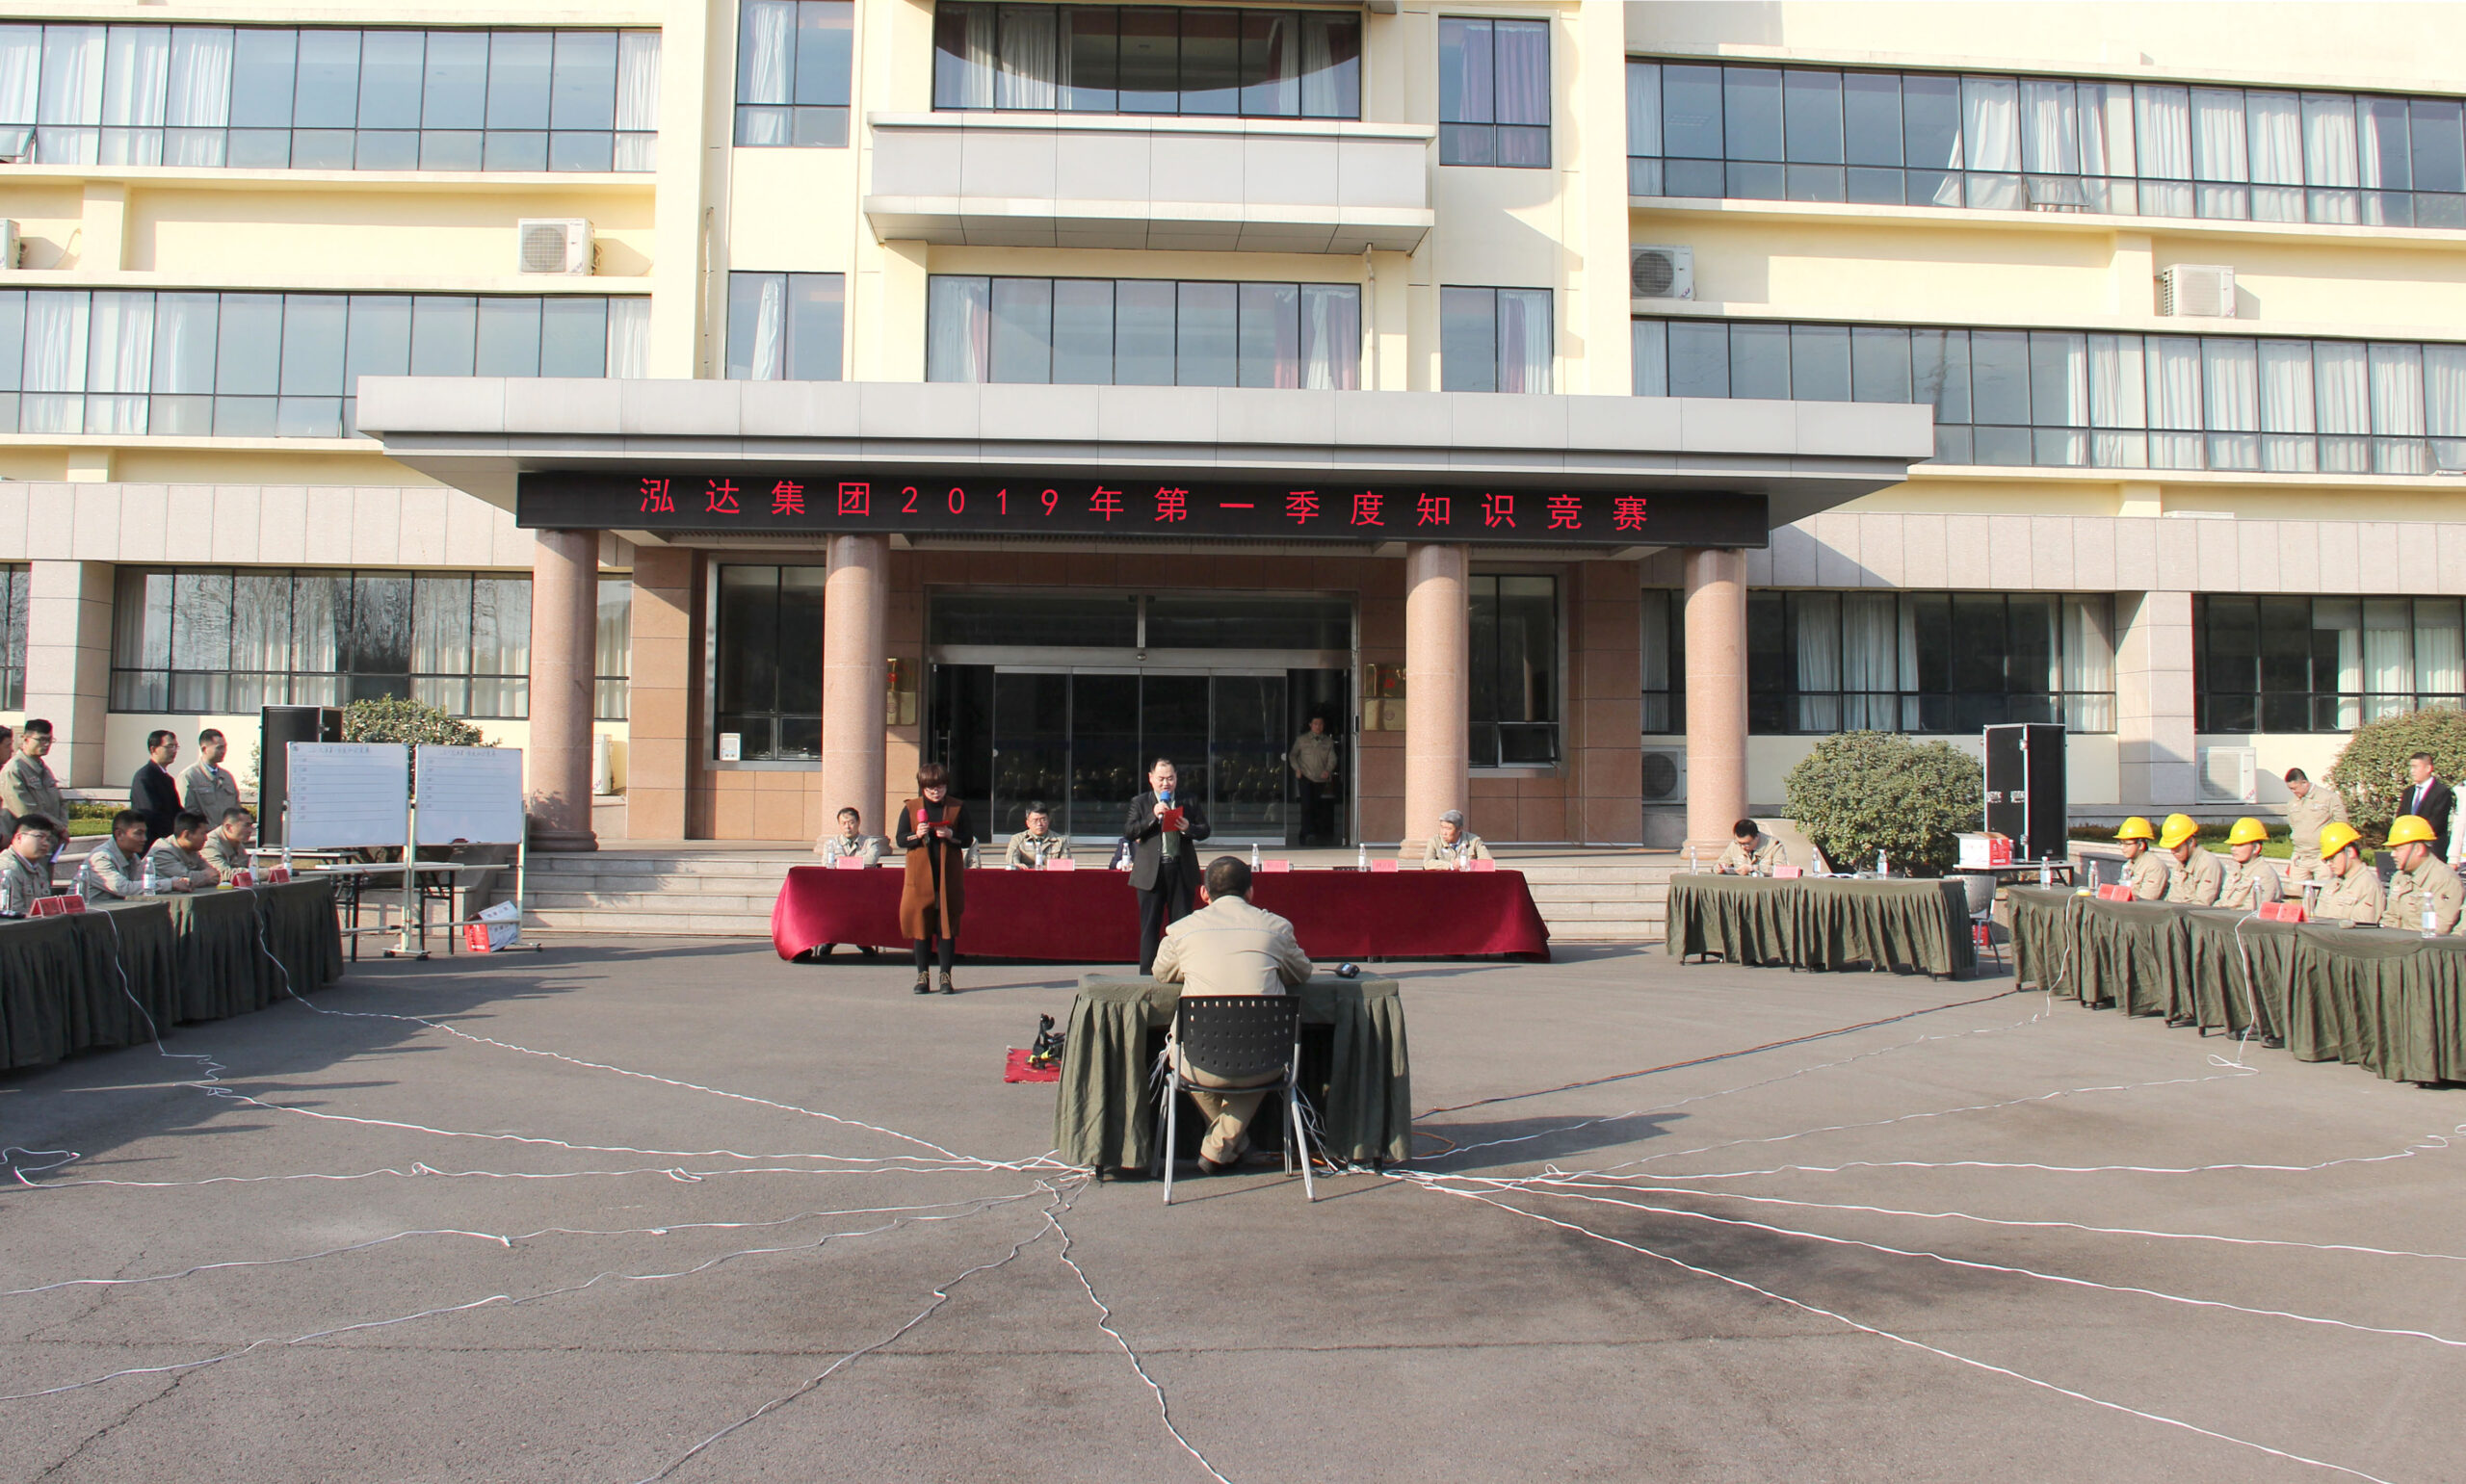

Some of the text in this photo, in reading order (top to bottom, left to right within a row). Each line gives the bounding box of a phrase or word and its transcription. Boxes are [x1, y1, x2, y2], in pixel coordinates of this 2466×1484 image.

[640, 478, 1648, 531] 泓达集团2019年第一季度知识竞赛
